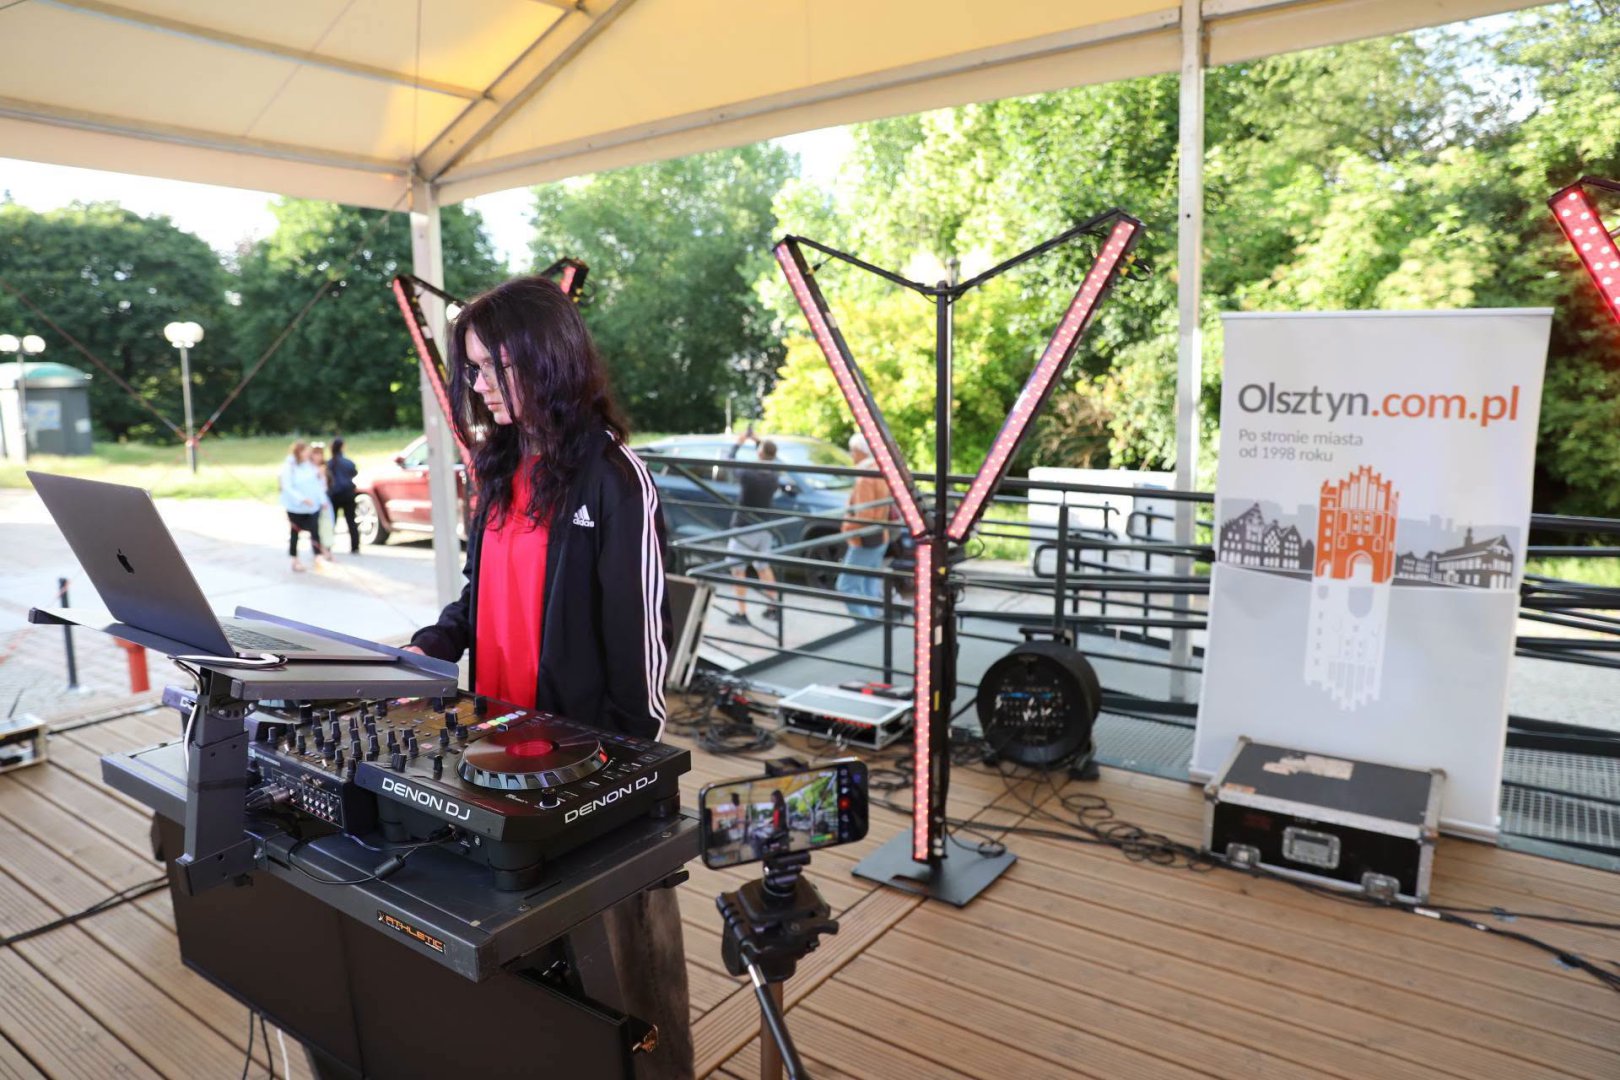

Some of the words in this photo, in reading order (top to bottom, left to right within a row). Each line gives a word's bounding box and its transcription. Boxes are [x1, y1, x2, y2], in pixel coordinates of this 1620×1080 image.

[1238, 382, 1520, 427] Olsztyn.com.pl
[1238, 428, 1257, 442] Po
[1261, 430, 1309, 444] stronie
[1313, 431, 1363, 446] miasta
[1239, 445, 1258, 458] od
[1262, 446, 1296, 461] 1998
[1300, 448, 1334, 462] roku
[381, 777, 444, 811] DENON
[445, 801, 471, 820] DJ
[564, 783, 632, 824] DENON
[635, 771, 658, 790] DJ
[385, 915, 444, 950] ATHLETIC
